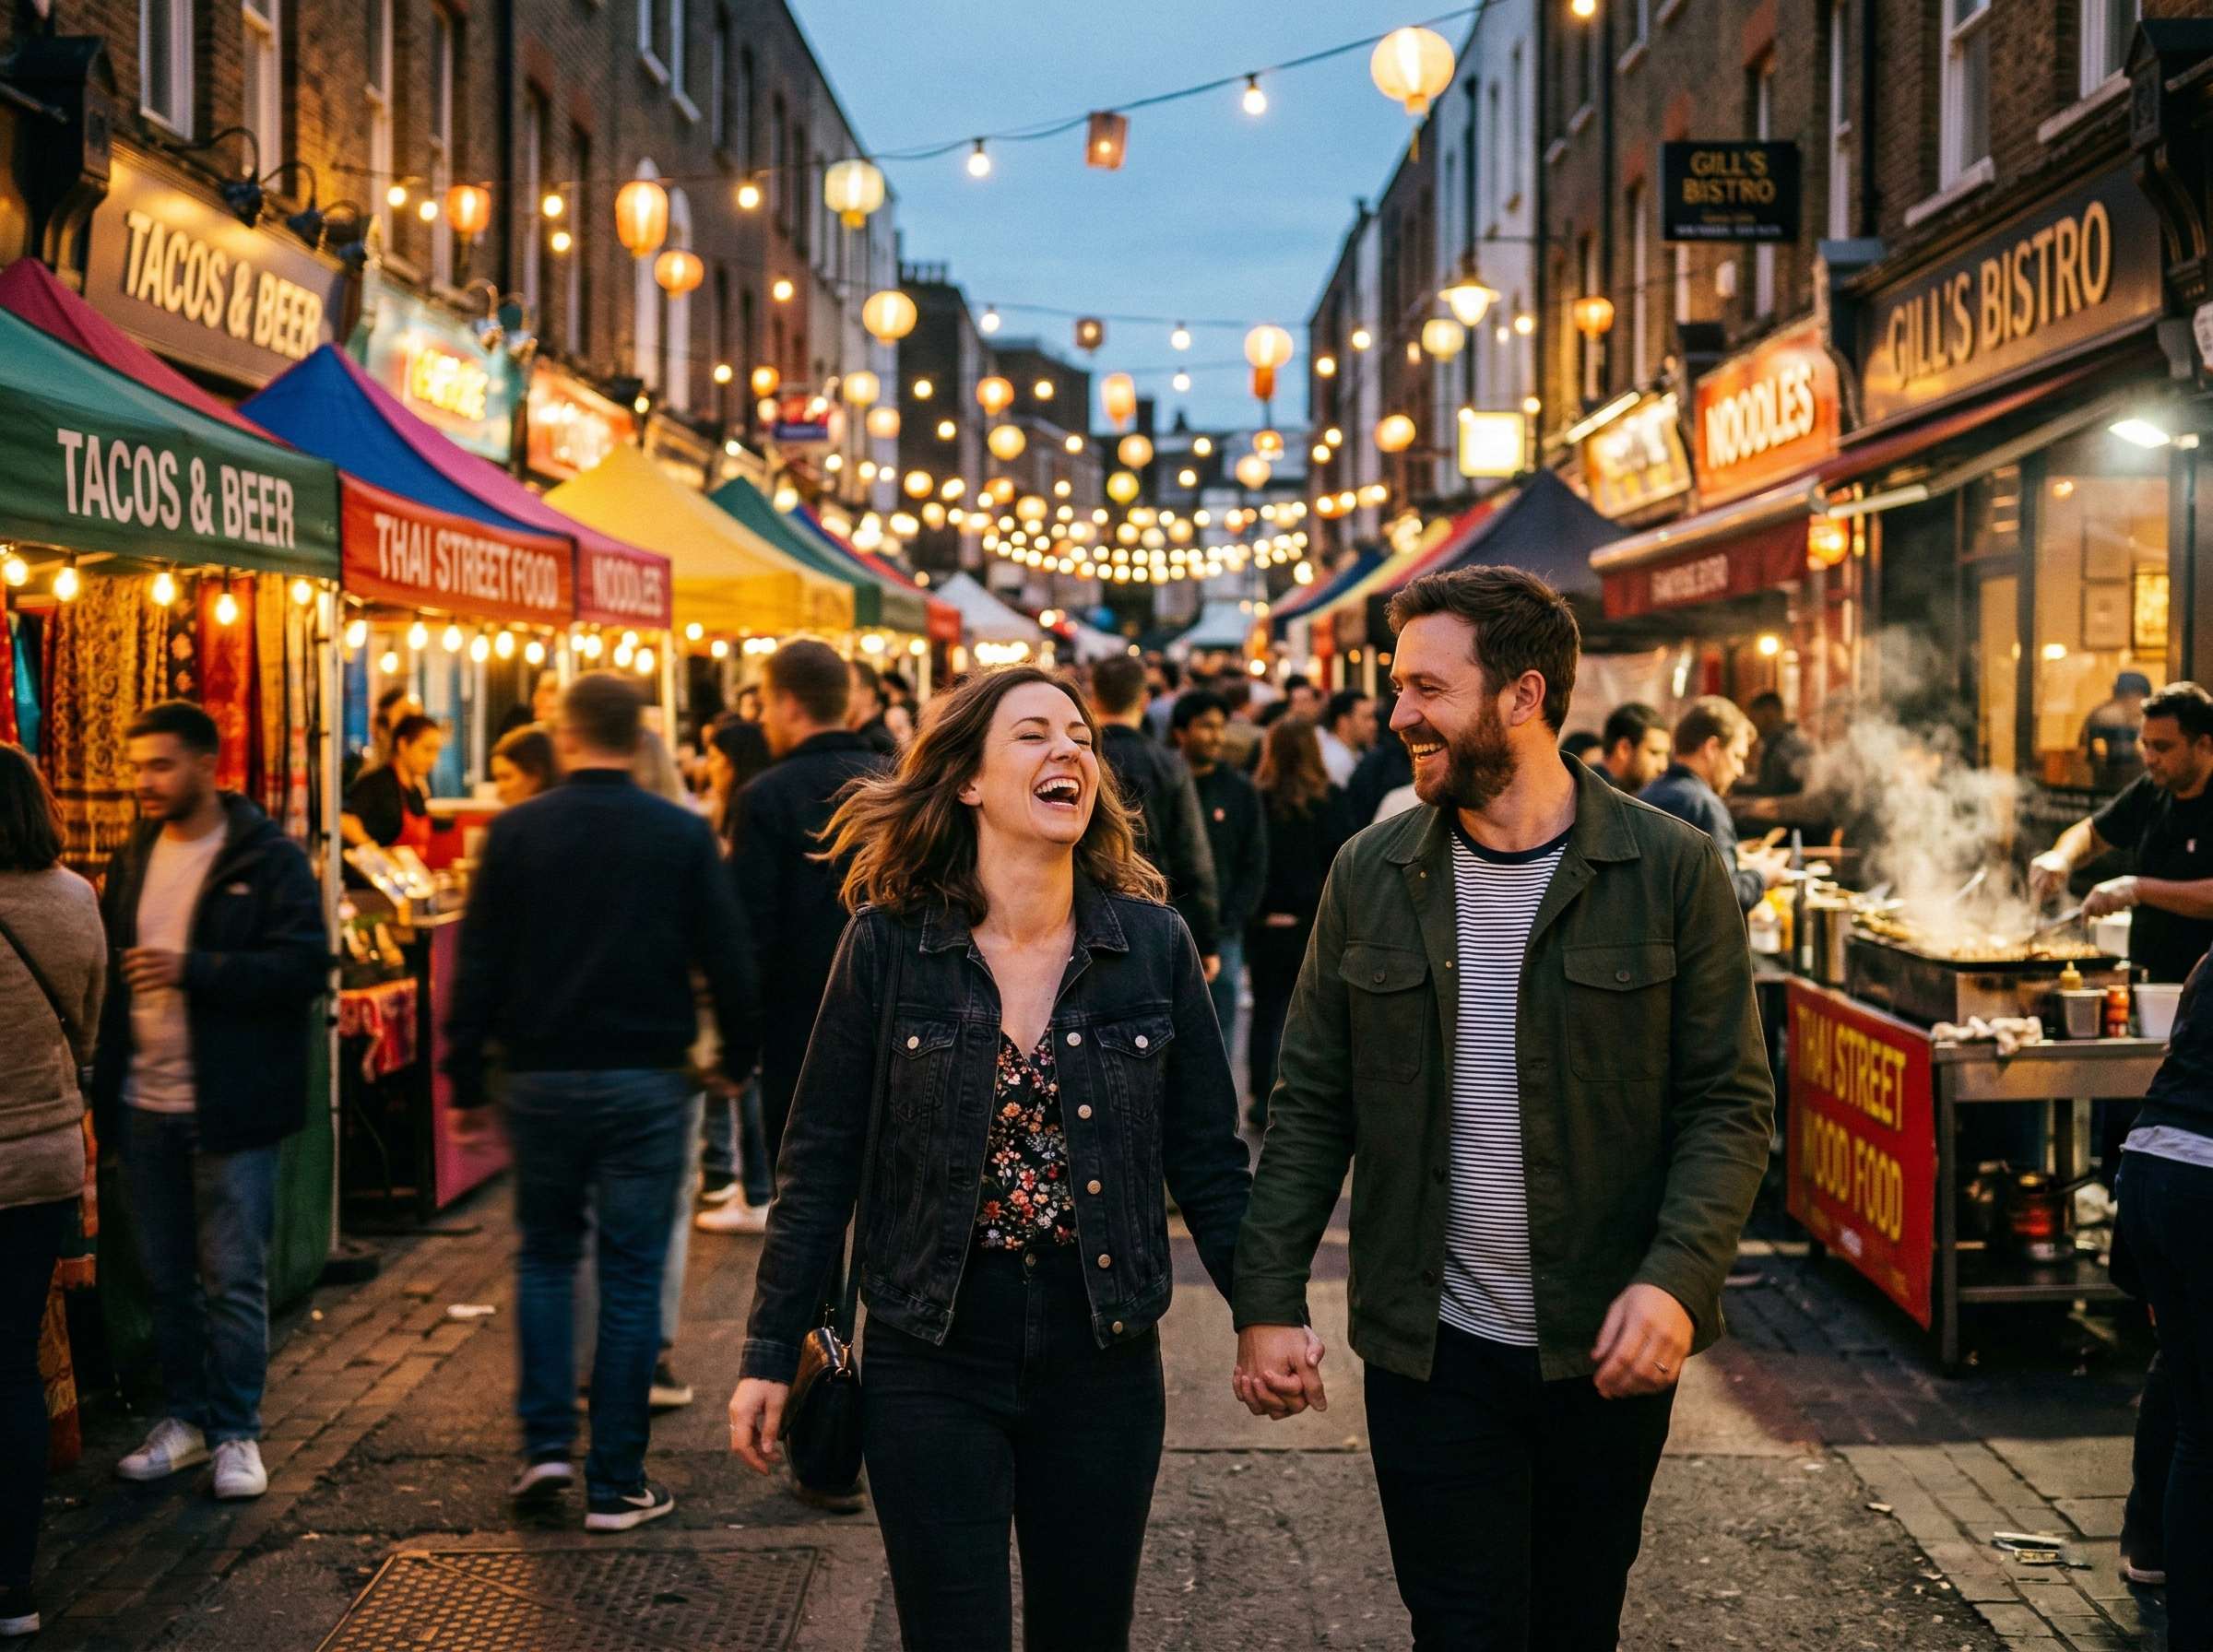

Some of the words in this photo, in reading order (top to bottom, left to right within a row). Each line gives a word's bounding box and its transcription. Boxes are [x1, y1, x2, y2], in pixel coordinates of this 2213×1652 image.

[1682, 177, 1777, 205] BISTRO
[1689, 150, 1768, 176] GILL'S
[125, 209, 229, 328] TACOS
[227, 260, 253, 340] &
[253, 271, 323, 360] BEER
[1887, 271, 1972, 386] GILL'S
[1981, 200, 2111, 351] BISTRO
[1705, 360, 1815, 470] NOODLES
[57, 428, 182, 531] TACOS
[190, 456, 215, 537] &
[220, 464, 295, 549] BEER
[373, 512, 432, 588] THAI
[435, 528, 510, 602] STREET
[511, 548, 559, 610] FOOD
[1796, 1002, 1833, 1092] THAI
[1834, 1023, 1907, 1132] STREET
[1853, 1136, 1904, 1243] FOOD
